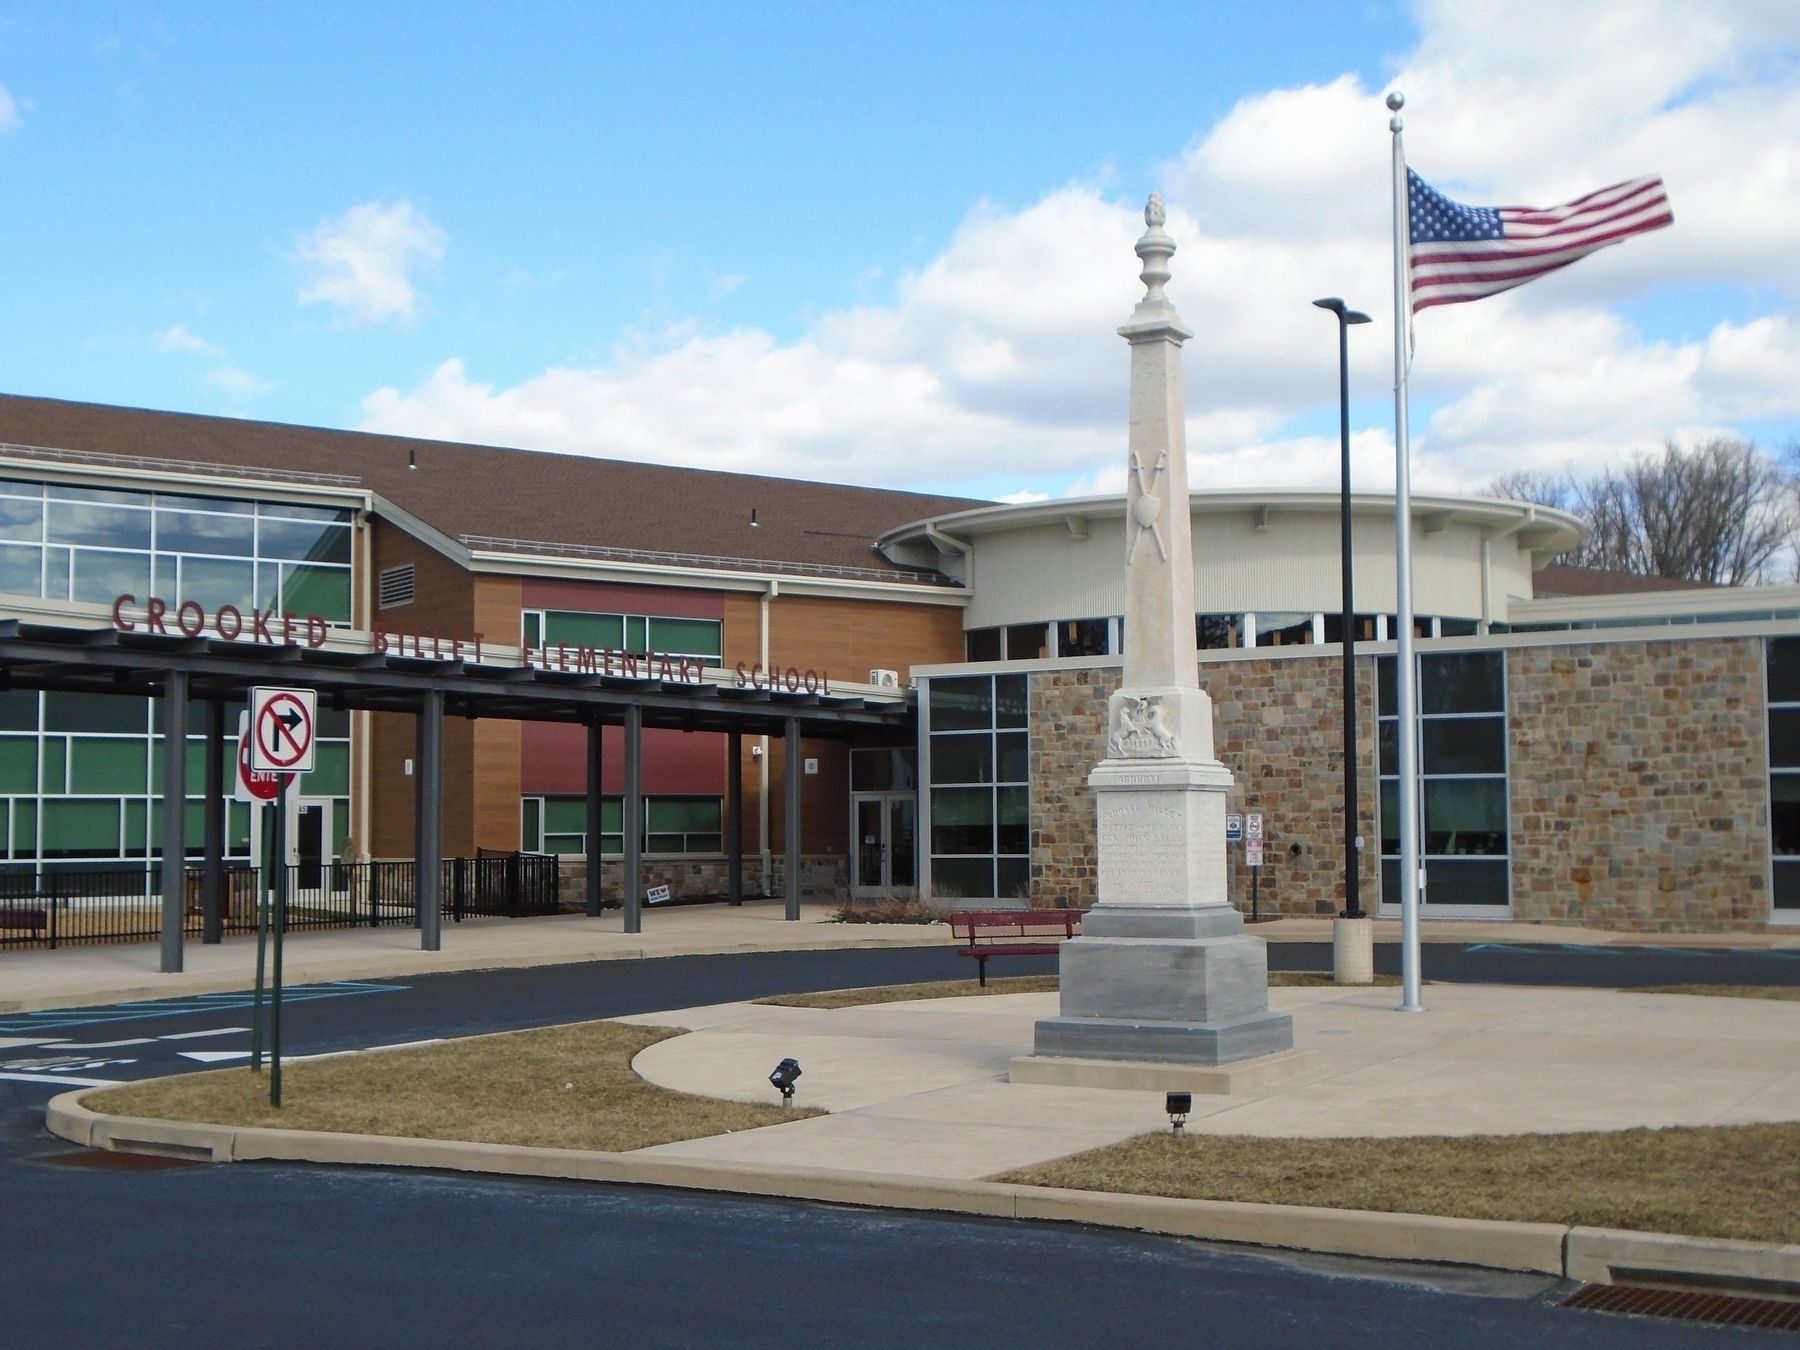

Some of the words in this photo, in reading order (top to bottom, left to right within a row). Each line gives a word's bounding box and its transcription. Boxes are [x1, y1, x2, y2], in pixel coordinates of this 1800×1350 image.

[112, 593, 327, 648] CROOKED
[373, 618, 485, 663] BILLET
[523, 637, 704, 684] ELEMENTARY
[736, 660, 831, 696] SCHOOL
[250, 772, 279, 782] ENTE
